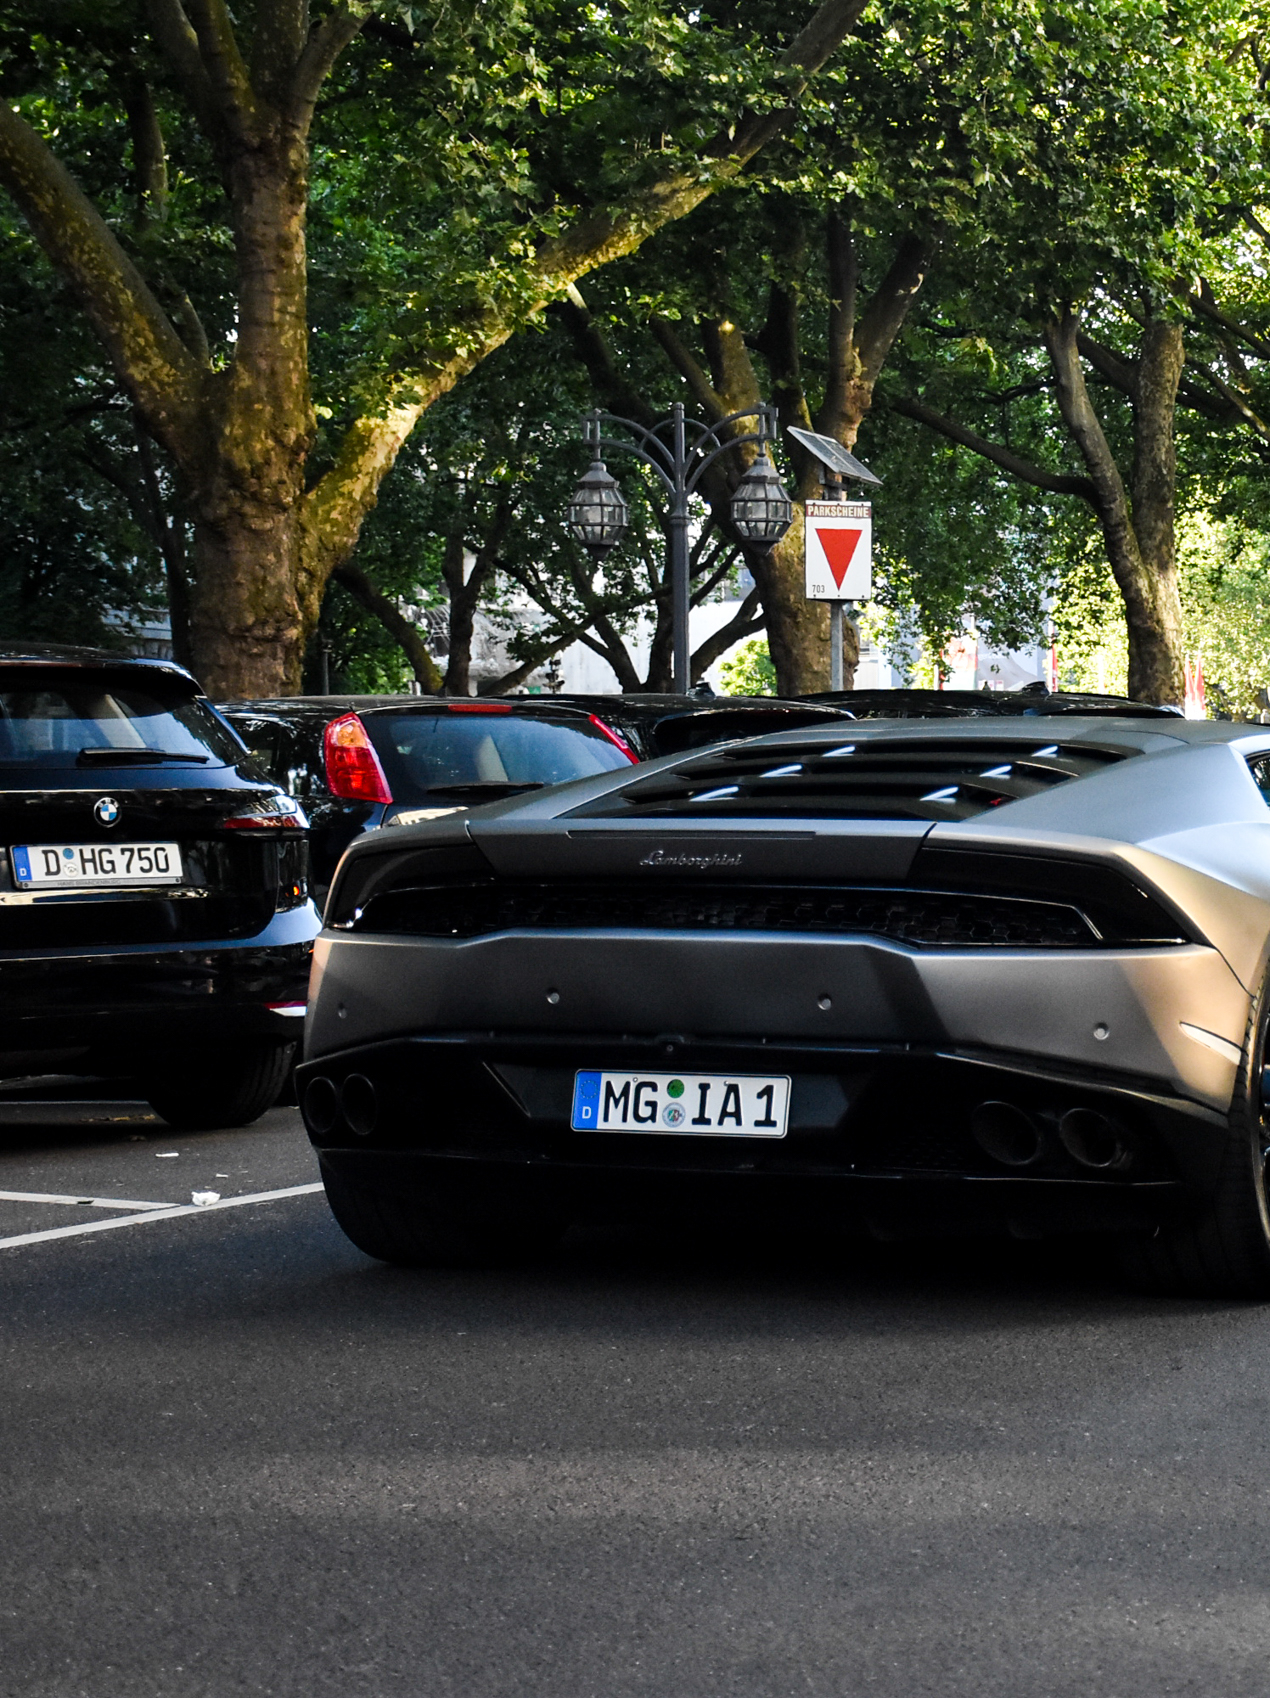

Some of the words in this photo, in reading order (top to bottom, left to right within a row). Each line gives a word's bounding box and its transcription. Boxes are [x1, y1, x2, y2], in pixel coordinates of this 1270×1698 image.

[807, 505, 869, 517] PARKSCHEINE
[812, 584, 825, 593] 703
[42, 849, 61, 876] D
[79, 848, 117, 875] HG
[120, 847, 170, 874] 750
[640, 849, 742, 869] Lamborghini
[603, 1080, 658, 1123] MG
[582, 1107, 592, 1119] D
